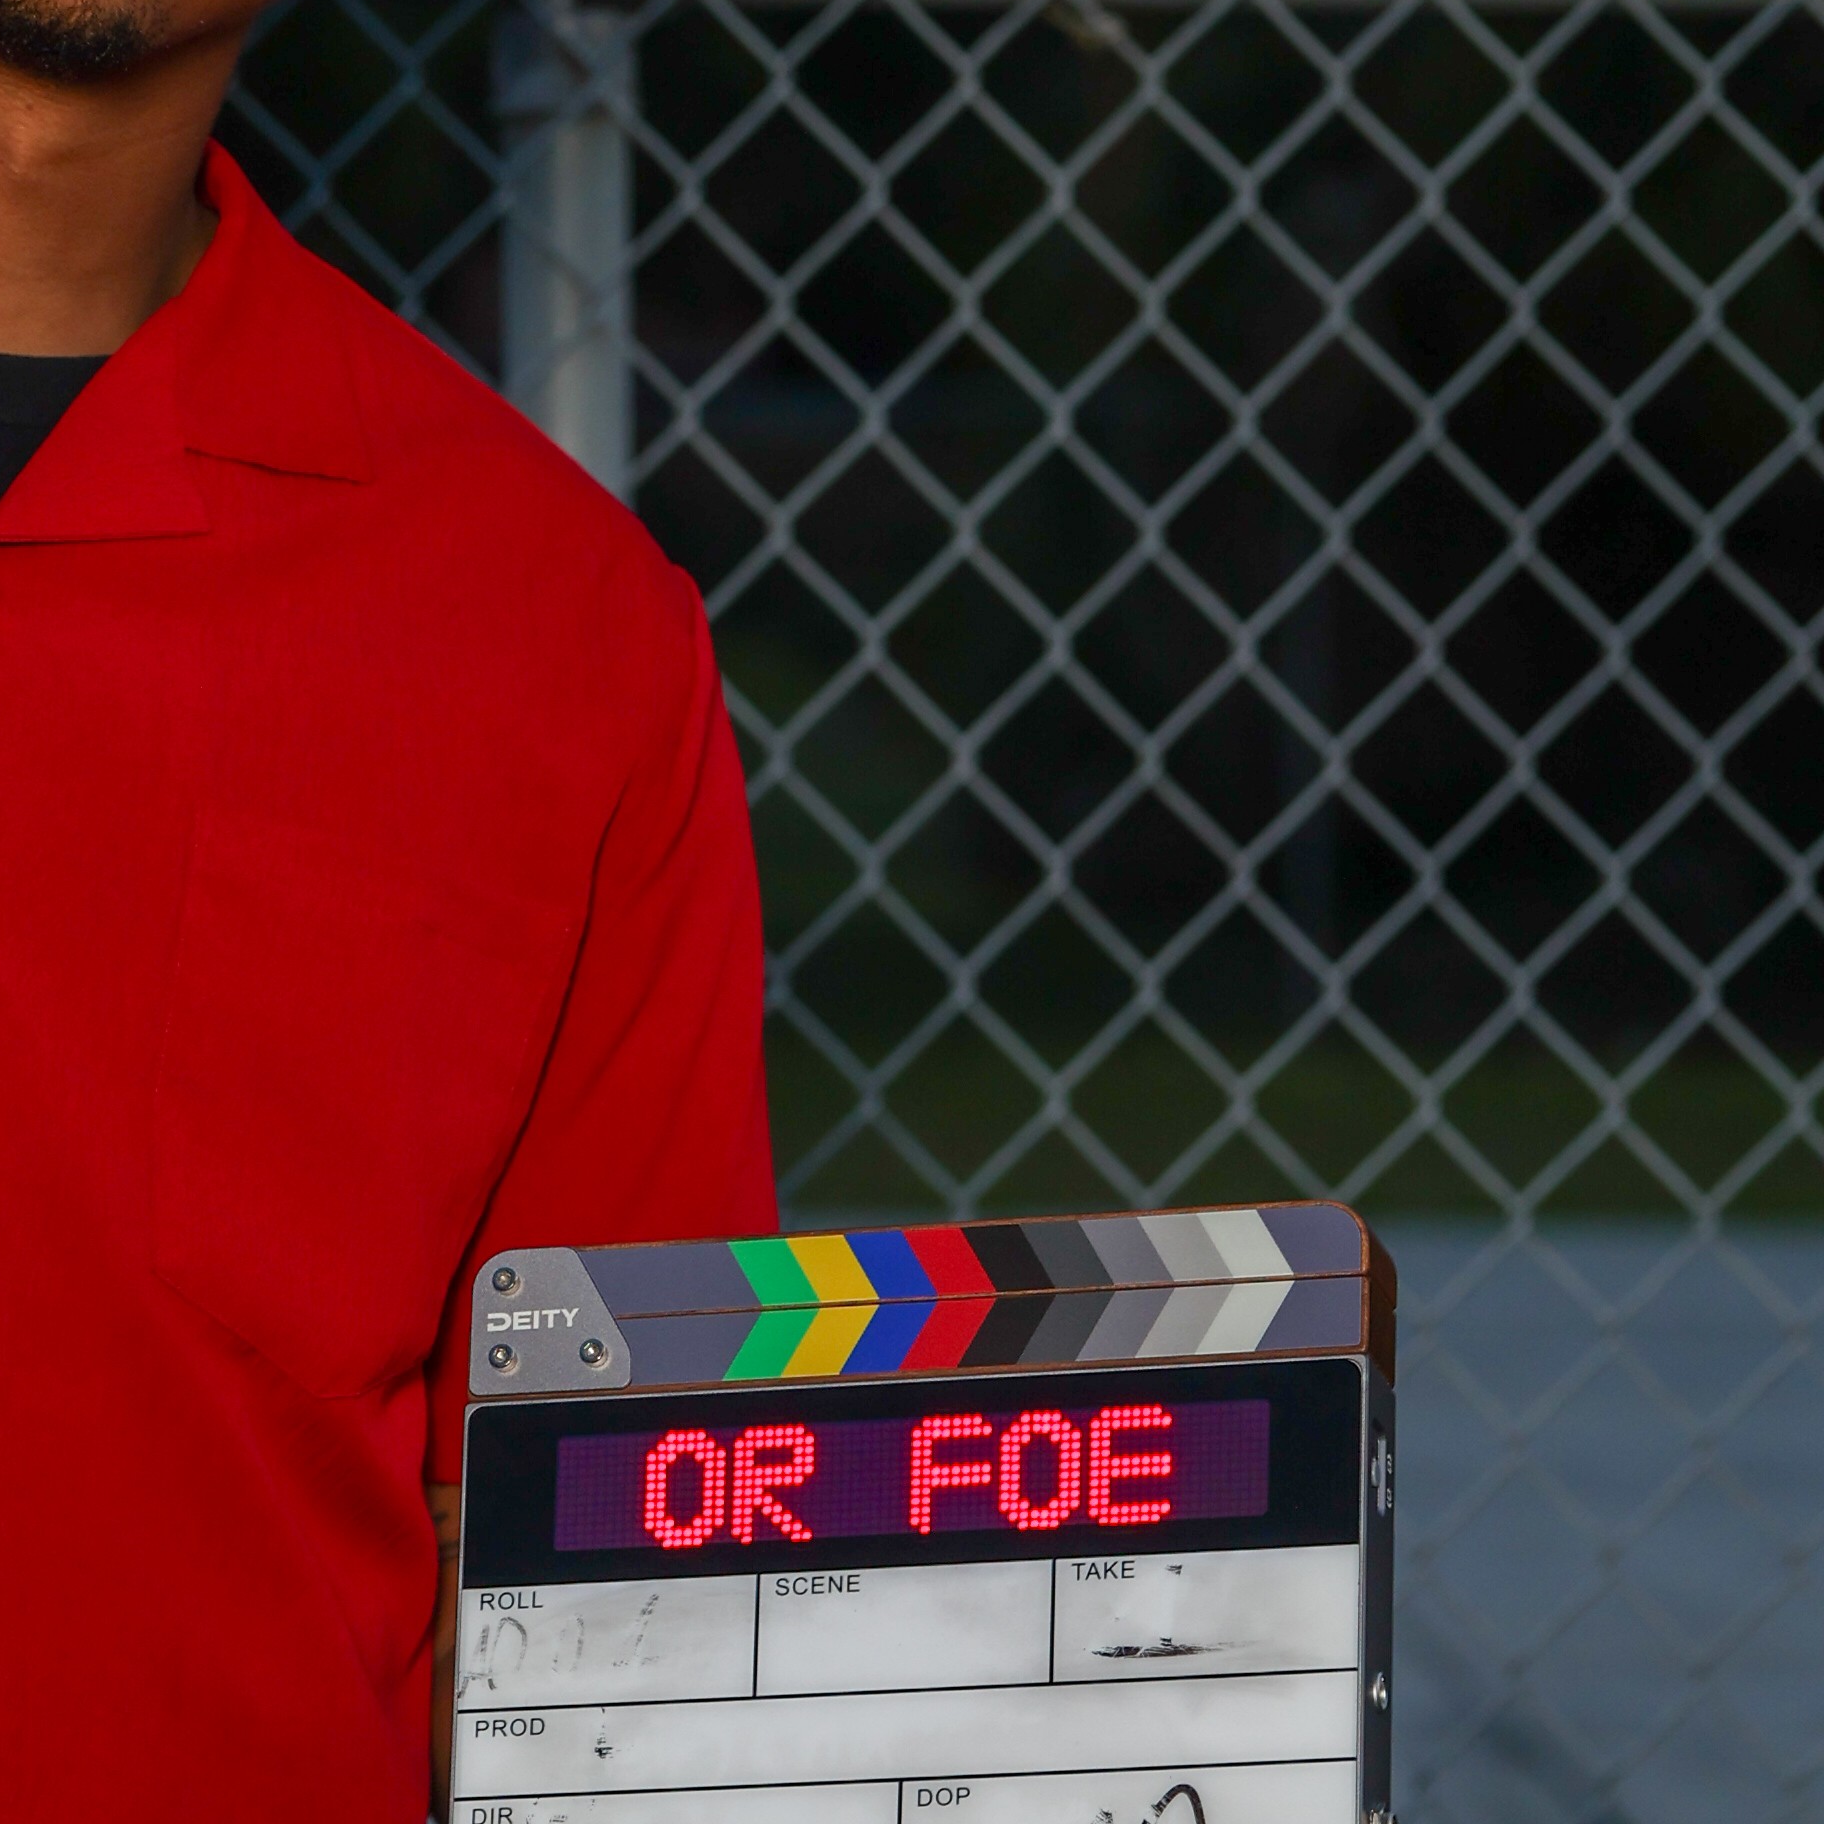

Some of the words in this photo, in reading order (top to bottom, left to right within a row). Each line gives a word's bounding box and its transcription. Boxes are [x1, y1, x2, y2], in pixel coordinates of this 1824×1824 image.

[486, 1306, 580, 1333] DEITY
[644, 1422, 816, 1550] OR
[908, 1403, 1173, 1536] FOE
[1070, 1559, 1137, 1582] TAKE
[775, 1573, 862, 1597] SCENE
[479, 1590, 544, 1611] ROLL
[474, 1717, 546, 1738] PROD
[916, 1786, 972, 1808] DOP
